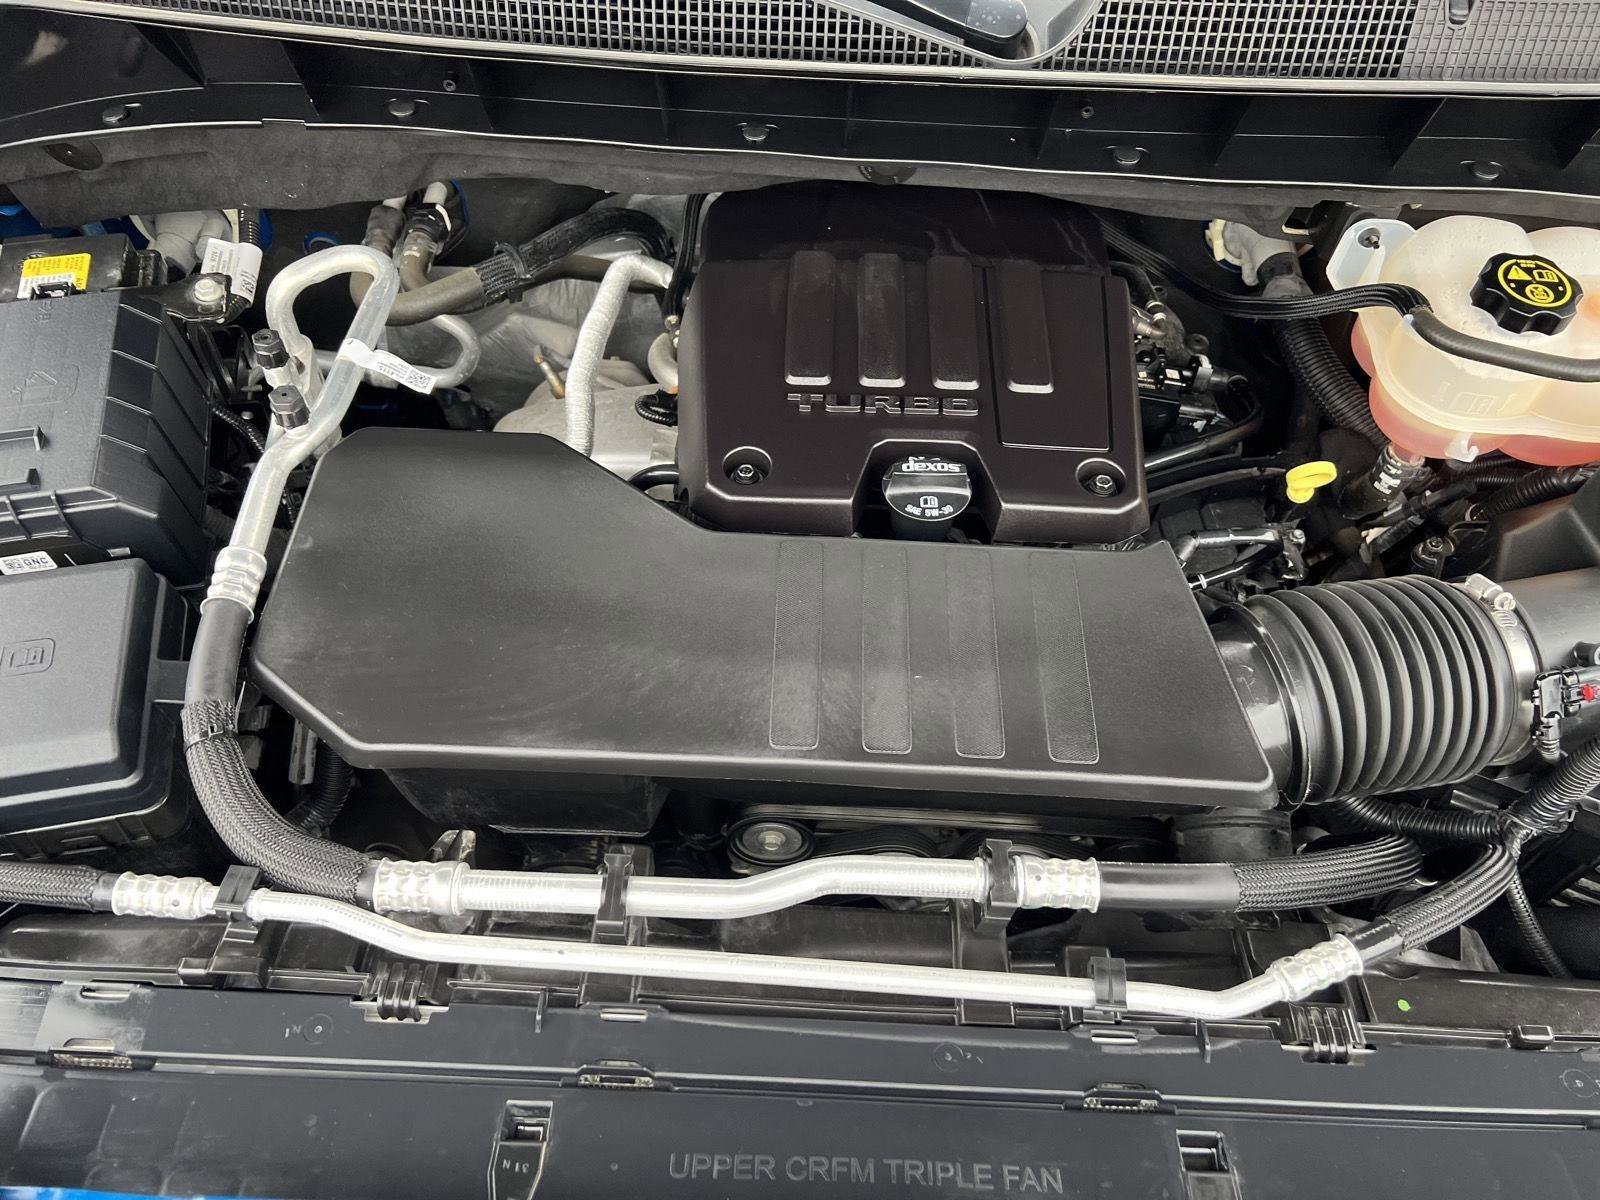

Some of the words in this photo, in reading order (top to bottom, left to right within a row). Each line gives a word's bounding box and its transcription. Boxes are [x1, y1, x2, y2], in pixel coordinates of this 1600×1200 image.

[787, 393, 979, 416] TURBO
[901, 457, 962, 473] dexos
[904, 503, 922, 516] SAE
[924, 503, 954, 517] 5W-30
[669, 1152, 776, 1181] UPPER
[785, 1155, 875, 1184] CRFM
[883, 1158, 994, 1190] TRIPLE
[1001, 1164, 1063, 1194] FAN
